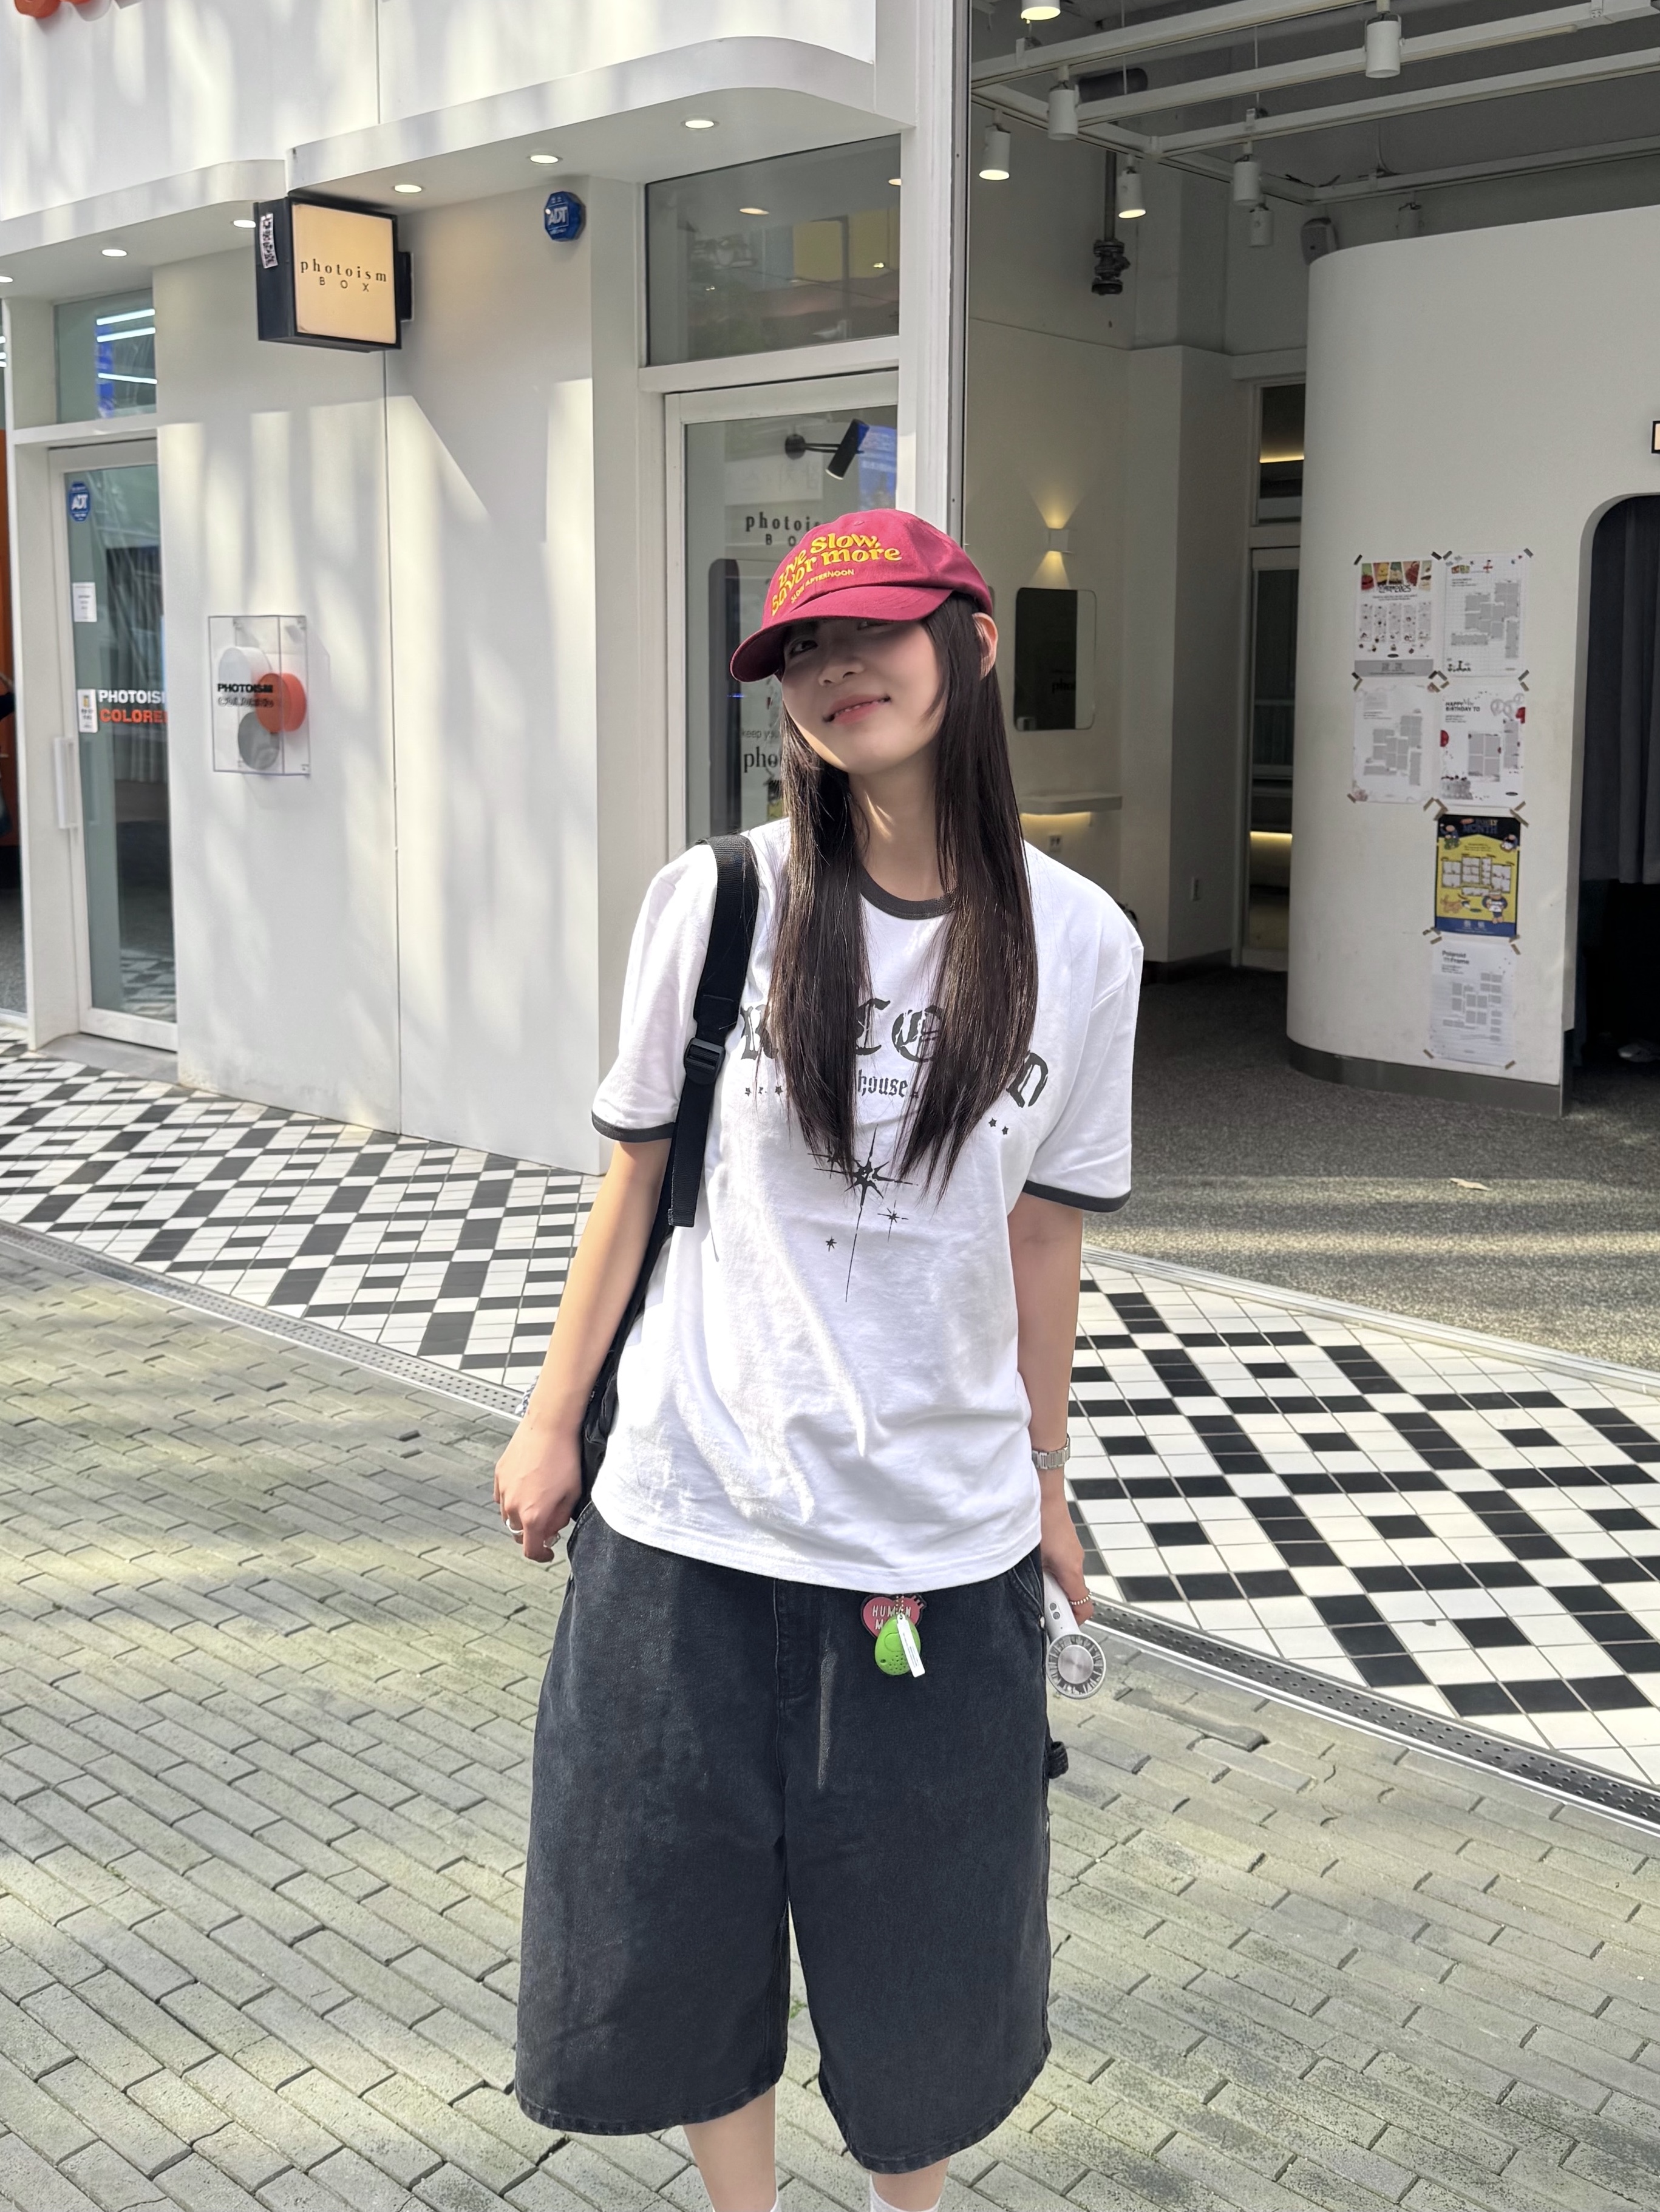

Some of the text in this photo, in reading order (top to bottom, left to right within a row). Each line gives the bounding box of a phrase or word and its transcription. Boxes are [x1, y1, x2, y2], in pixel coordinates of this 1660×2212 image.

[548, 206, 568, 226] ADT
[300, 259, 387, 282] photoism
[319, 277, 370, 292] BOX
[71, 494, 89, 511] ADT
[746, 511, 820, 532] photoi
[765, 534, 797, 547] BO
[778, 532, 882, 589] Live Slow,
[771, 548, 903, 617] Savor more
[805, 568, 855, 588] AFTERNOON
[857, 1068, 908, 1098] house
